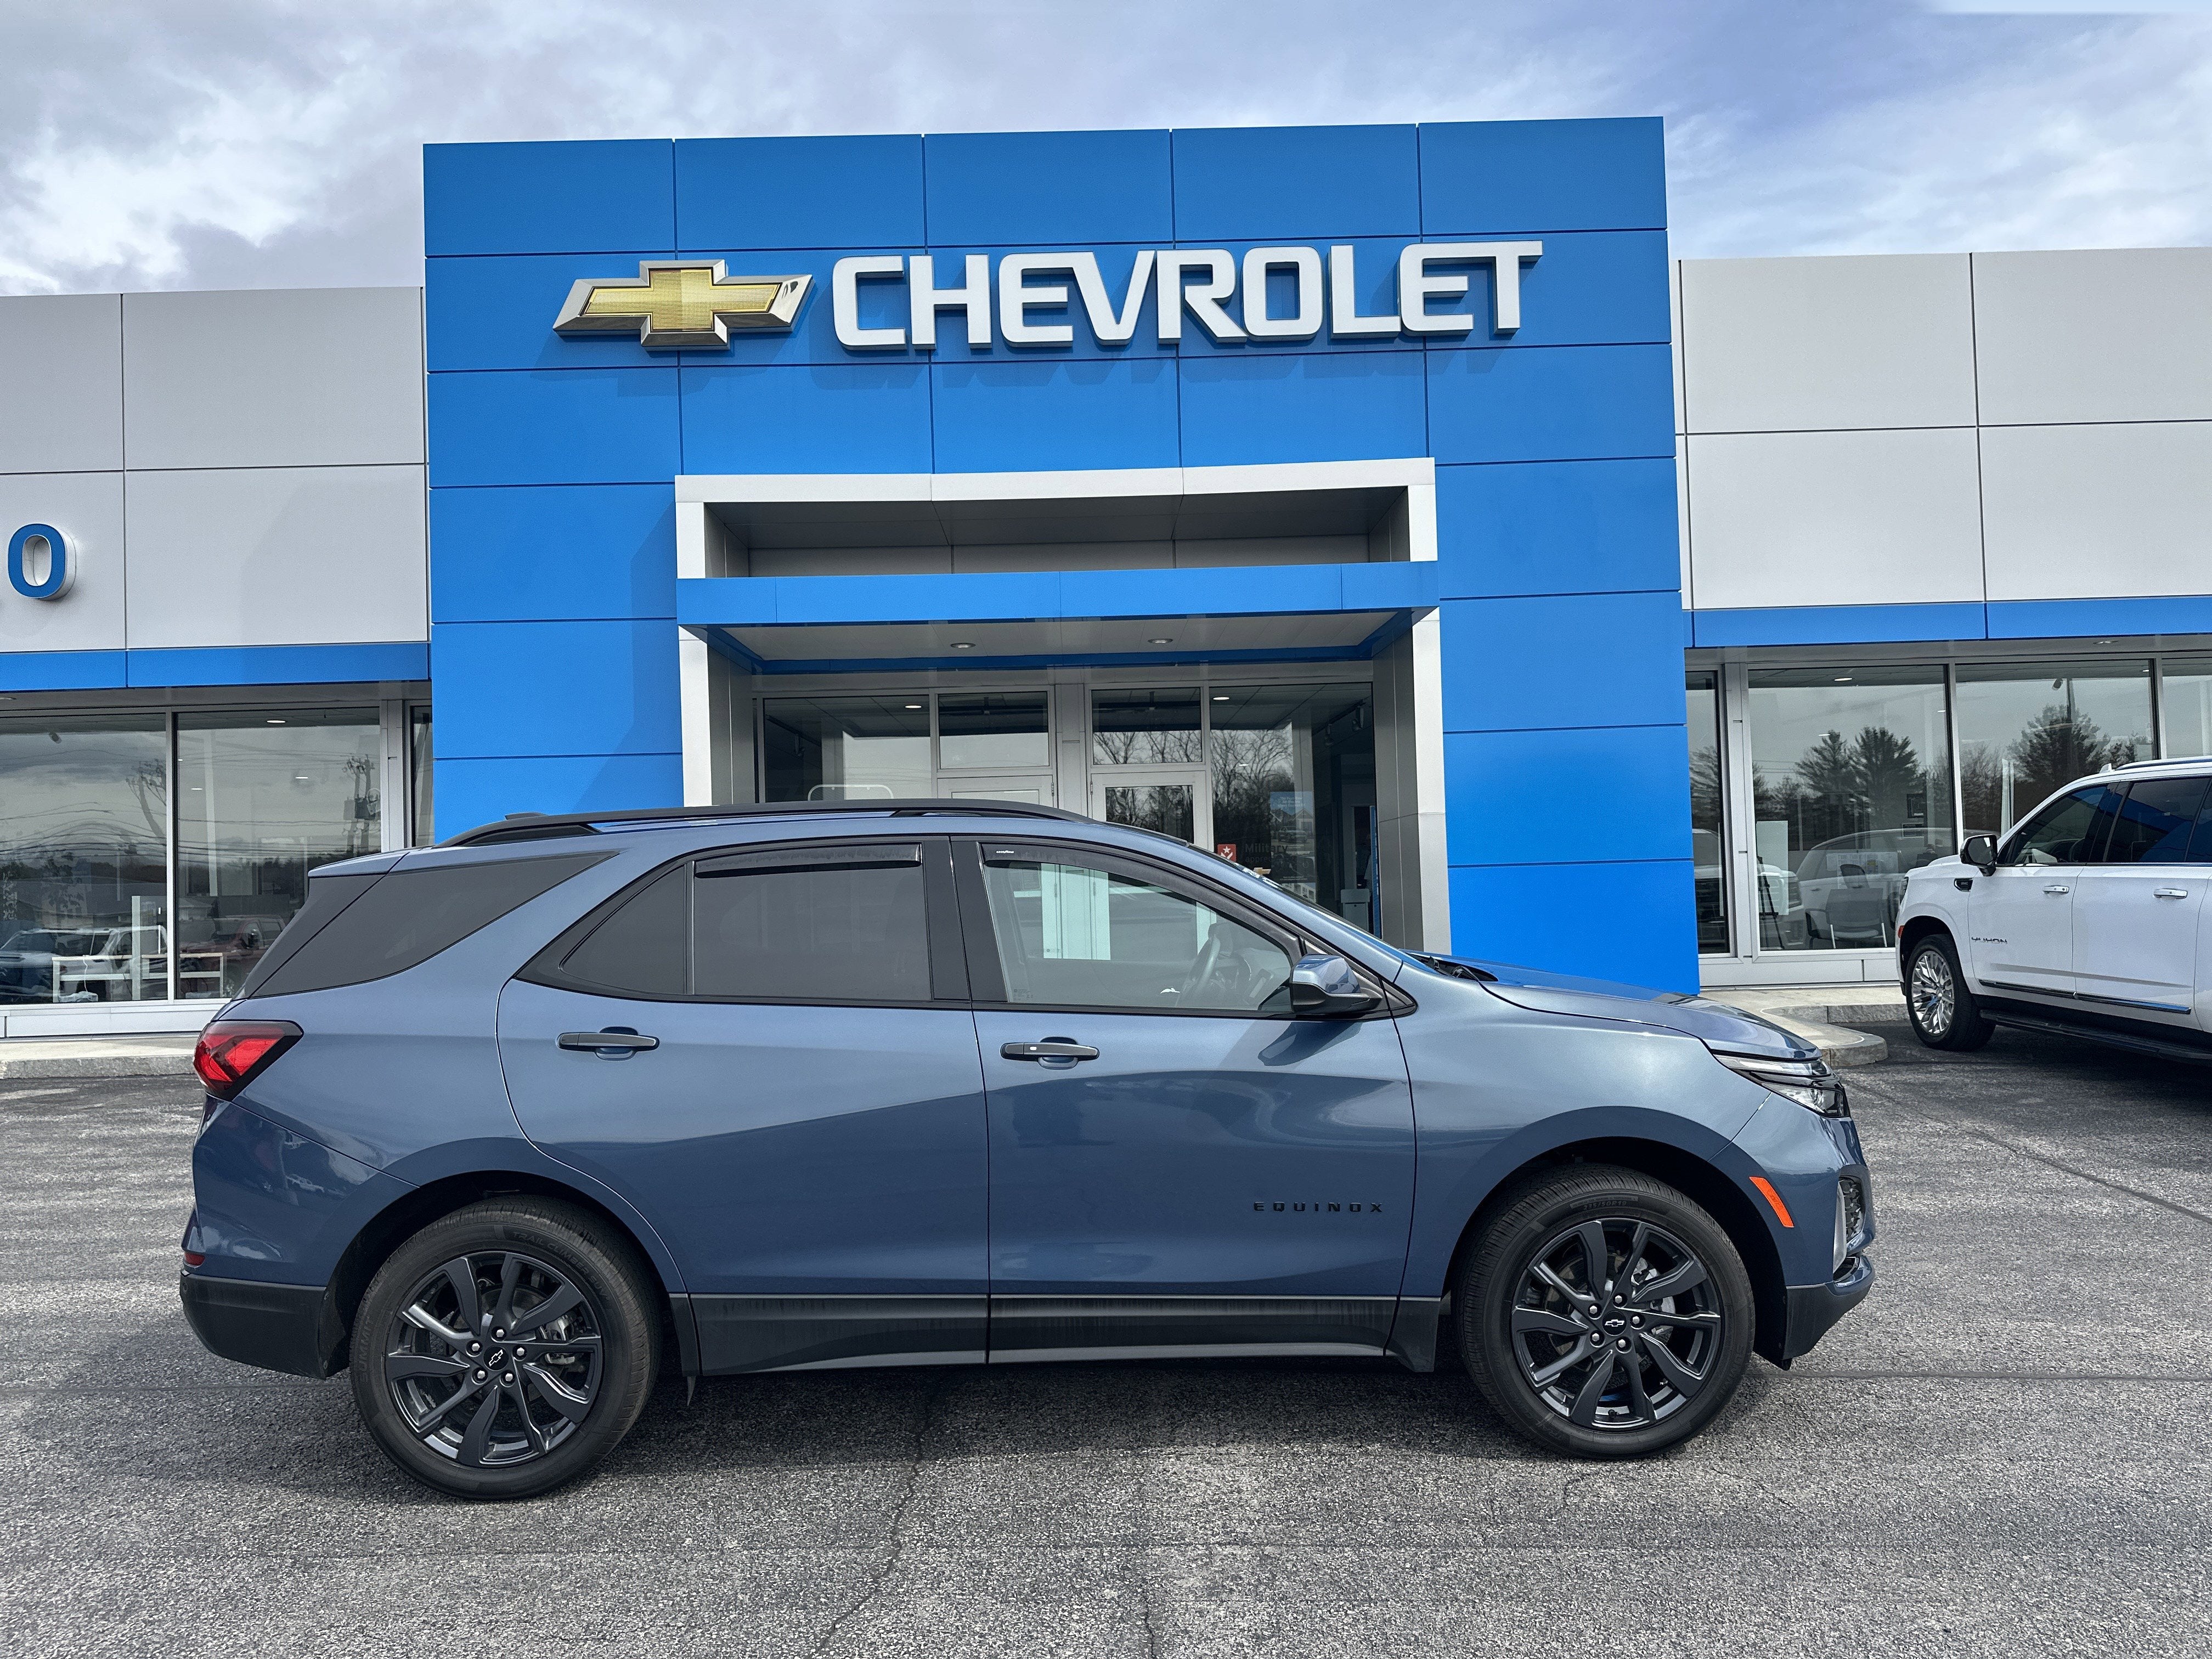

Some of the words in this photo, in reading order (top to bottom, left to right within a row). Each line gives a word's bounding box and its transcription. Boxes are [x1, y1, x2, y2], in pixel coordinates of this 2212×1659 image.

[832, 240, 1543, 351] CHEVROLET
[1245, 843, 1288, 854] Military
[1254, 1201, 1383, 1213] EQUINOX
[512, 1231, 544, 1246] TRAIL
[547, 1243, 590, 1276] CLIMBER
[588, 1275, 607, 1297] SUV
[359, 1314, 374, 1383] SUMMIT
